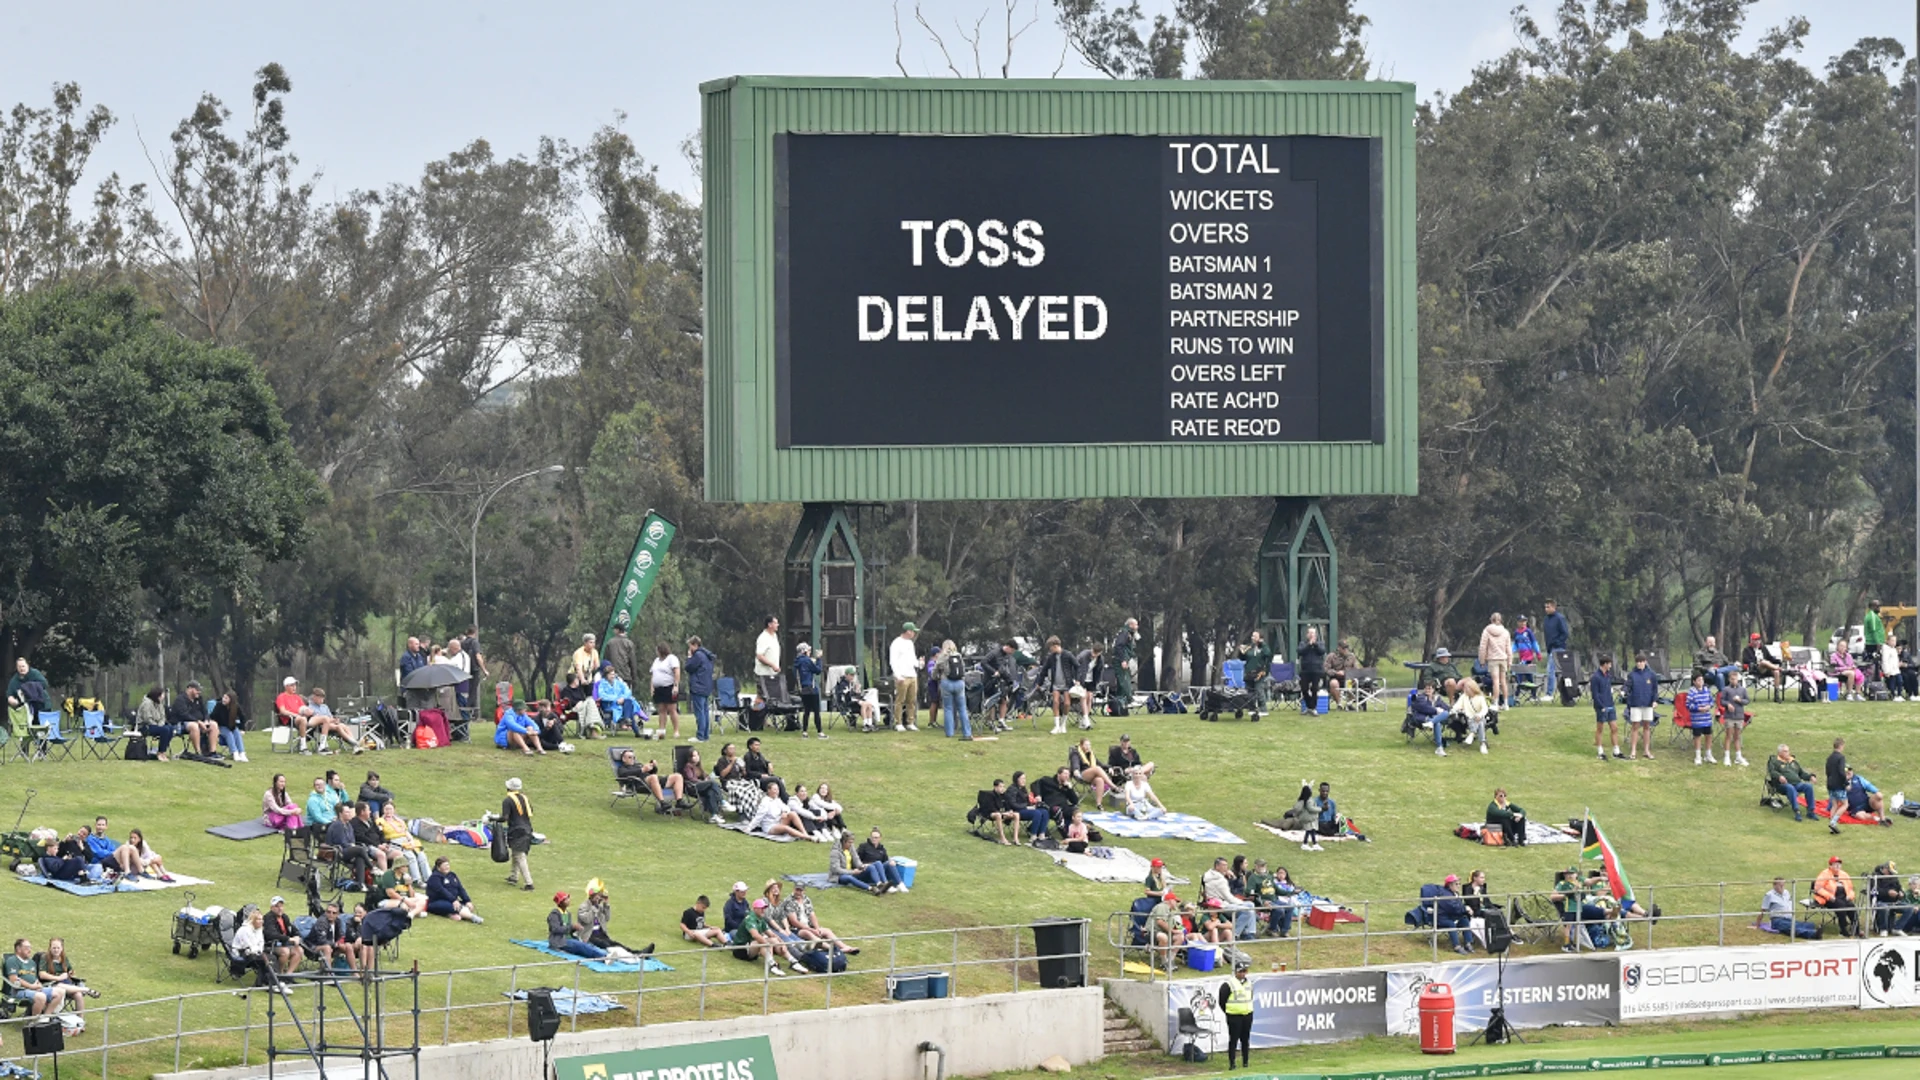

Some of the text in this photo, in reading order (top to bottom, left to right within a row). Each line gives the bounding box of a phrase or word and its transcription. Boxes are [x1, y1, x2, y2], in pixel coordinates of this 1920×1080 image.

[1169, 143, 1280, 174] TOTAL
[1169, 190, 1275, 211] WICKETS
[1169, 222, 1249, 243] OVERS
[901, 219, 1045, 267] TOSS
[1168, 256, 1271, 273] BATSMAN 1
[1169, 283, 1273, 300] BATSMAN 2
[858, 296, 1107, 341] DELAYED
[1170, 310, 1300, 328] PARTNERSHIP
[1170, 337, 1294, 355] RUNS TO WIN
[1171, 364, 1287, 382] OVERS LEFT
[1171, 391, 1280, 409] RATE ACH'D
[1171, 419, 1281, 438] RATE REQ'D
[1259, 986, 1377, 1009] WILLOWMOORE
[1483, 983, 1610, 1006] EASTERN STORM
[1297, 1012, 1336, 1031] PARK
